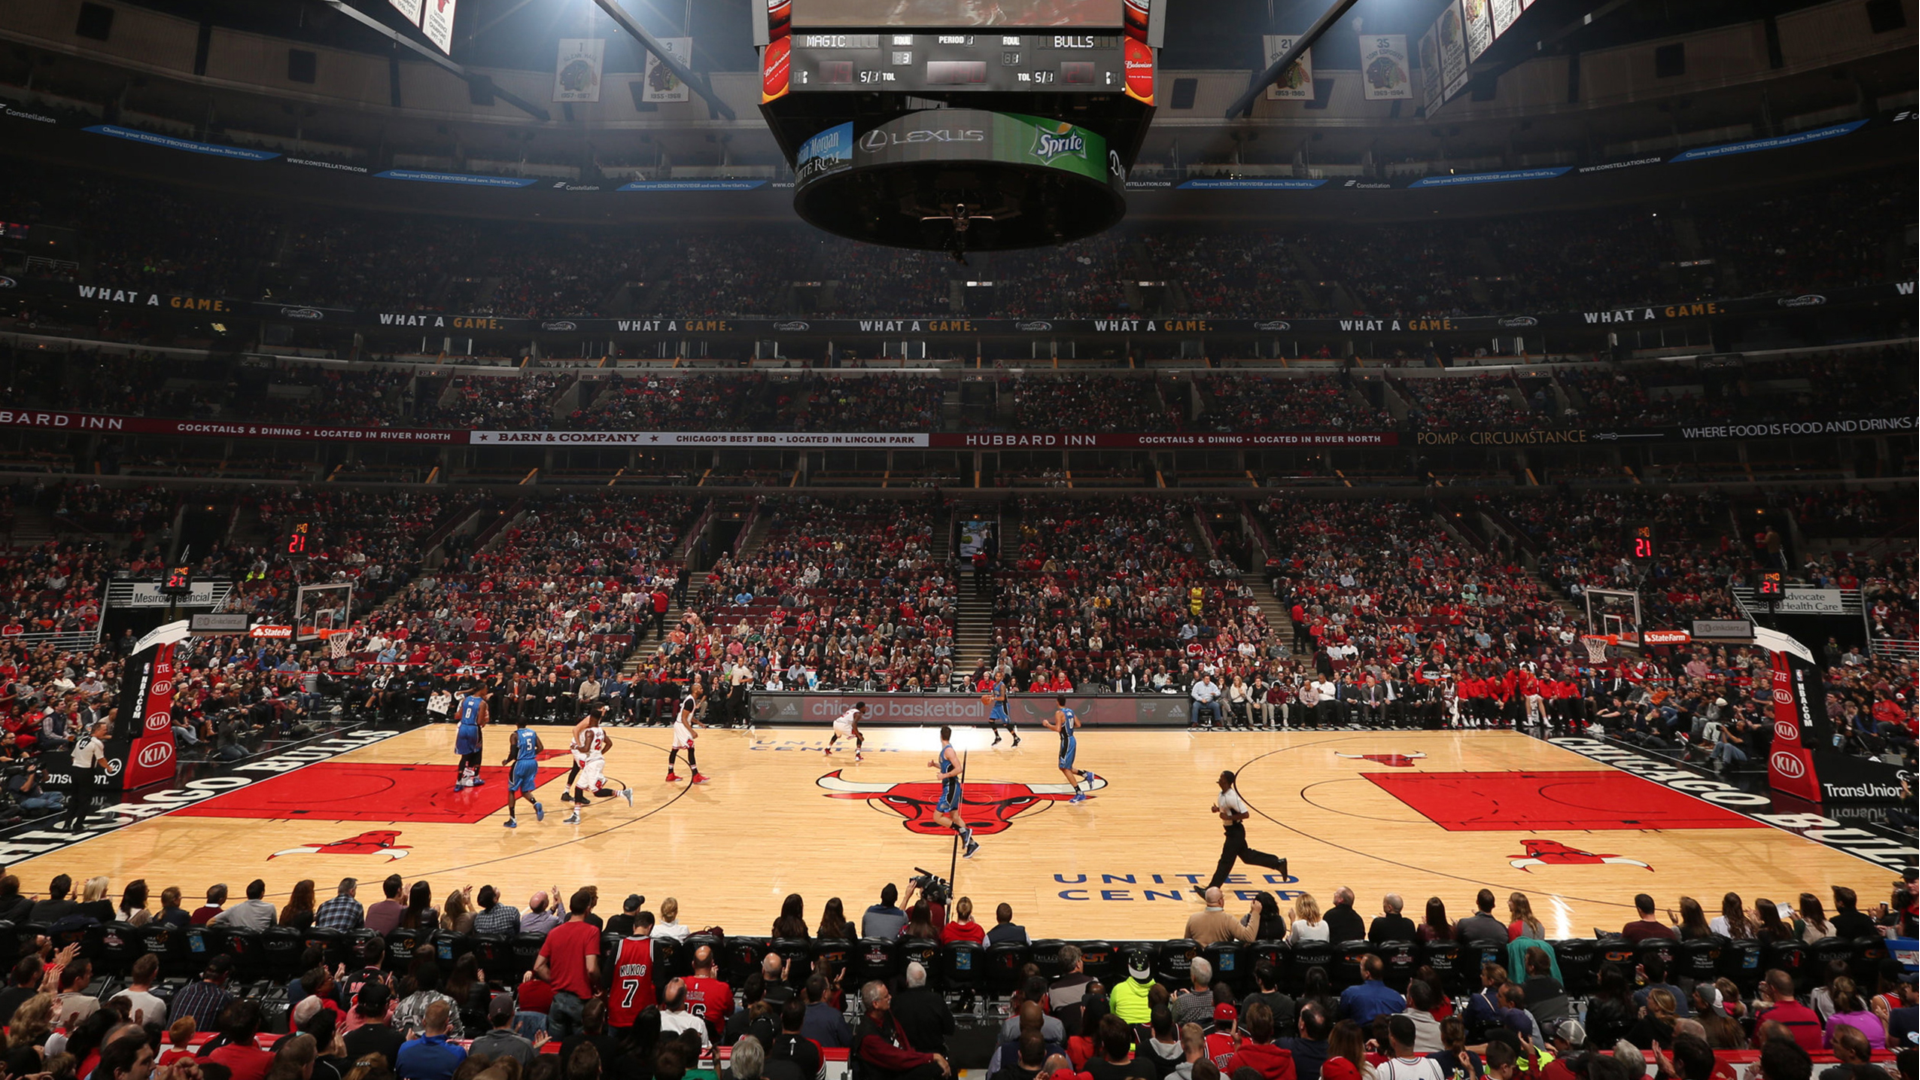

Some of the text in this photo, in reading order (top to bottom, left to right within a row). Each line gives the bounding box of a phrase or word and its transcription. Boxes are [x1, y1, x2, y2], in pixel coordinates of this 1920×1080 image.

[806, 36, 845, 47] MAGIC
[939, 36, 964, 44] PERIOD
[1054, 35, 1094, 48] BULLS
[1281, 39, 1293, 49] 21
[1377, 38, 1390, 48] 35
[666, 42, 673, 52] 3
[903, 53, 909, 64] 3
[1125, 60, 1152, 69] Budweiser
[882, 73, 896, 81] TOL
[1018, 73, 1030, 82] TOL
[6, 108, 56, 124] Constellation
[102, 126, 125, 136] Choose
[126, 130, 140, 140] your
[140, 134, 166, 144] ENERGY
[166, 139, 198, 150] PROVIDER
[892, 130, 984, 144] LEXUS
[1038, 133, 1083, 159] Sprite
[1720, 144, 1746, 152] ENERGY
[1746, 140, 1778, 149] PROVIDER
[286, 157, 368, 173] WWW.CONSTELLATION.COM
[814, 152, 840, 172] RUM
[1578, 157, 1661, 173] WWW.CONSTELLATION.COM
[78, 284, 230, 312] WHAT A GAME.
[1584, 303, 1726, 324] WHAT A GAME.
[380, 313, 505, 330] WHAT A GAME.
[618, 320, 734, 332] WHAT A GAME.
[860, 320, 978, 332] WHAT A GAME.
[1094, 320, 1214, 332] WHAT A GAME.
[1340, 319, 1460, 332] WHAT A GAME.
[0, 411, 123, 430] BARD INN
[177, 423, 245, 434] COCKTAILS
[261, 427, 302, 436] DINING
[314, 430, 362, 438] LOCATED
[380, 431, 413, 440] RIVER
[415, 432, 451, 440] NORTH
[1682, 416, 1912, 439] WHERE FOOD IS FOOD AND DRINKS
[498, 433, 640, 442] BARN & COMPANY
[756, 436, 776, 444] BBQ
[786, 436, 829, 444] LOCATED
[832, 436, 842, 444] IN
[846, 436, 886, 444] LINCOLN
[890, 436, 915, 444] PARK
[966, 434, 1096, 446] HUBBARD INN
[1138, 436, 1194, 444] COCKTAILS
[1198, 436, 1205, 444] &
[1208, 436, 1244, 444] DINING
[1254, 436, 1298, 444] LOCATED
[1301, 436, 1312, 444] IN
[1417, 432, 1459, 444] POMP
[1470, 430, 1588, 445] CIRCUMSTANCE
[288, 534, 306, 553] 21
[1635, 538, 1652, 558] 21
[168, 576, 184, 588] 21
[1762, 582, 1778, 594] 21
[134, 593, 171, 603] Mesiro
[1781, 602, 1839, 610] Health Care
[263, 628, 292, 637] StateFar
[1650, 634, 1686, 642] StateFarm
[157, 664, 170, 674] ZTE
[1774, 671, 1787, 682] ZTE
[464, 707, 472, 719] 8
[812, 700, 985, 719] chicgo basketball
[526, 738, 533, 751] 5
[144, 746, 167, 763] KIA
[233, 730, 400, 772] BULLS
[1548, 736, 1771, 805] CHICAGO
[1776, 755, 1800, 775] KIA
[1053, 874, 1300, 884] UNITED
[1058, 890, 1307, 901] CENER
[620, 964, 646, 978] KUKOC
[622, 979, 640, 1008] 7
